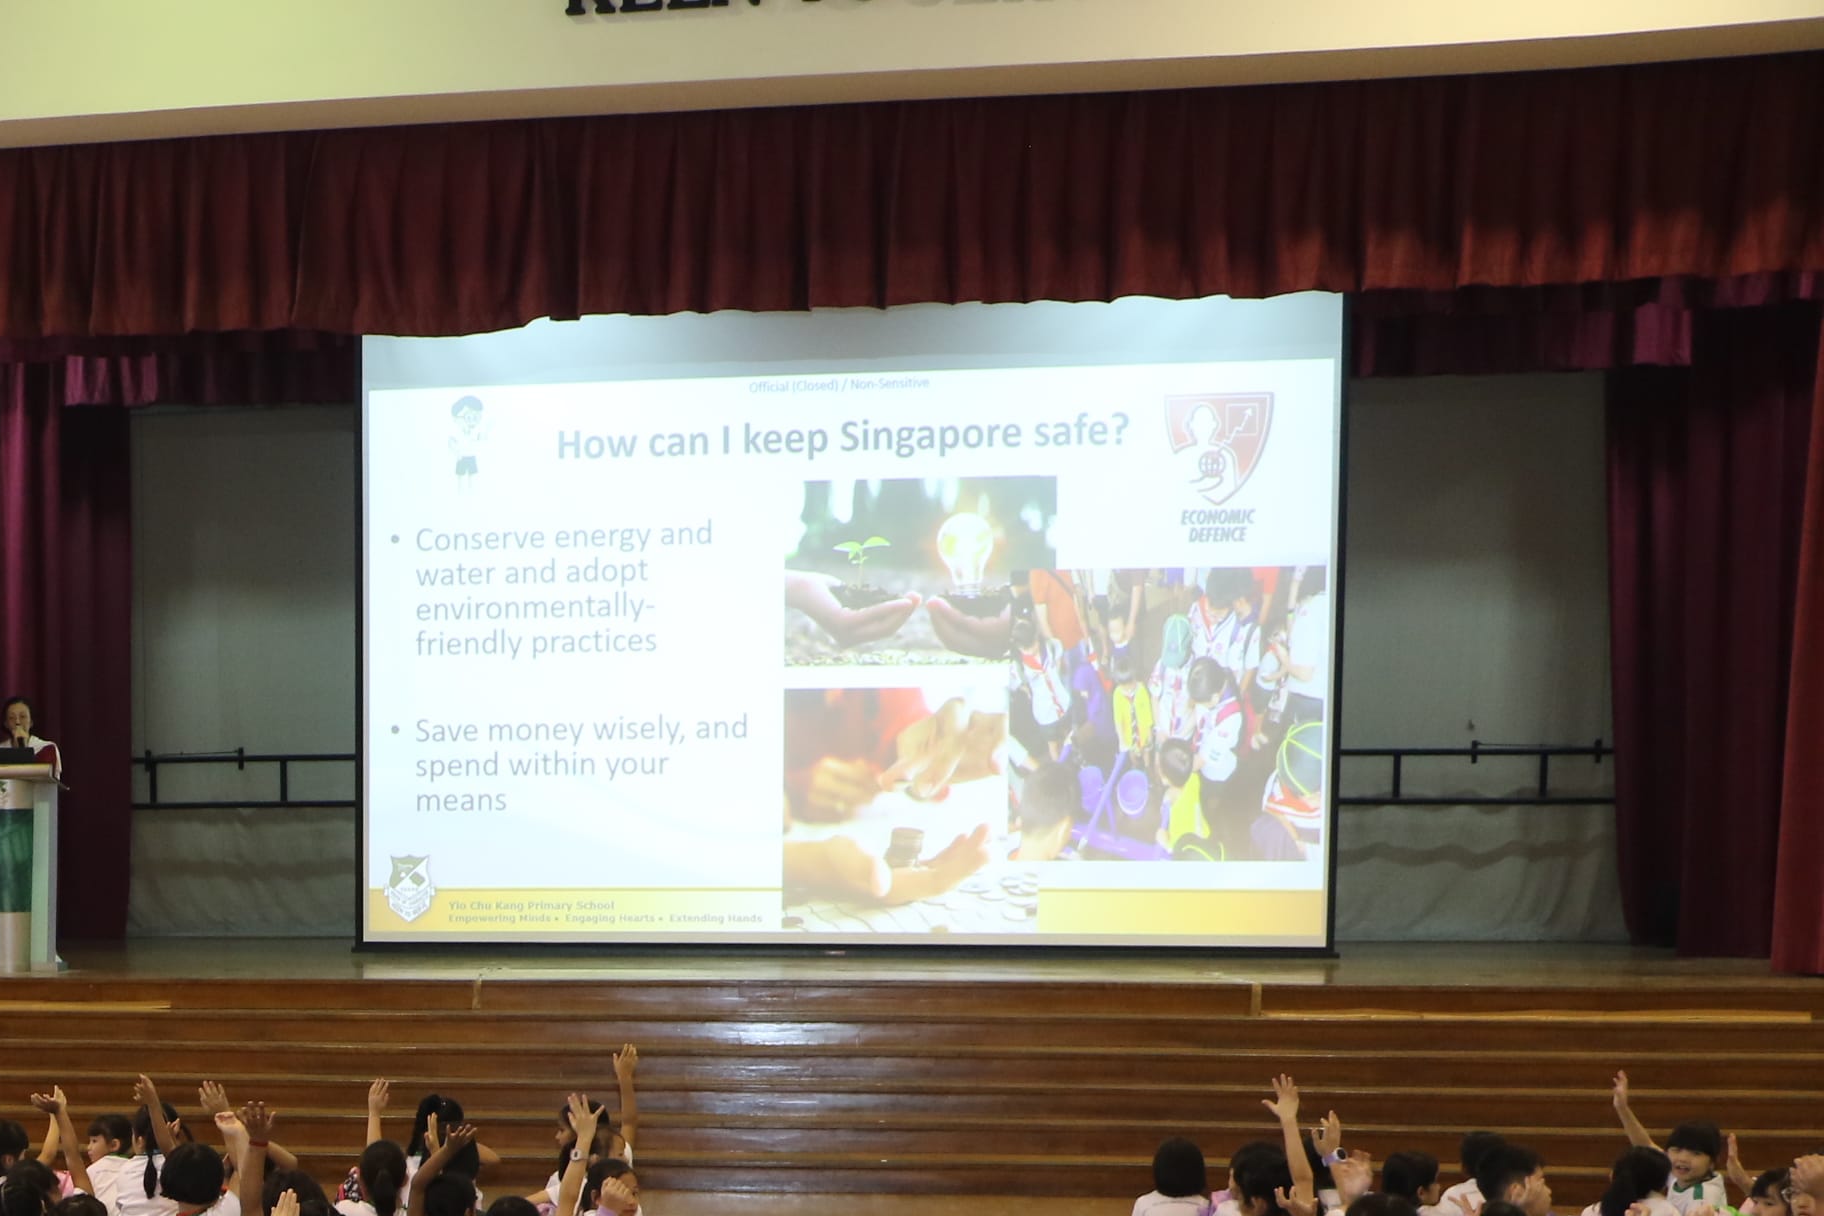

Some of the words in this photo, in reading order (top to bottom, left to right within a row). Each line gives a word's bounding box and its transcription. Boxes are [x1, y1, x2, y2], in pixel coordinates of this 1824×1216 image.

[749, 380, 789, 393] Official
[792, 379, 840, 393] (Closed)
[850, 378, 930, 391] Non-Sensitive
[559, 431, 637, 459] How
[649, 432, 708, 456] can
[723, 426, 729, 454] I
[745, 423, 828, 460] keep
[841, 419, 1021, 458] Singapore
[1035, 412, 1128, 446] safe?
[1181, 509, 1256, 525] ECONOMIC
[416, 528, 544, 551] Conserve
[555, 528, 651, 552] energy
[661, 519, 711, 545] and
[1188, 526, 1247, 542] DEFENCE
[416, 564, 495, 586] water
[505, 558, 555, 584] and
[567, 557, 648, 587] adopt
[417, 591, 654, 622] environmentally-
[416, 629, 522, 659] friendly
[533, 629, 656, 659] practices
[416, 719, 478, 742] Save
[489, 723, 584, 746] money
[594, 714, 685, 745] wisely,
[696, 713, 747, 739] and
[416, 752, 497, 782] spend
[509, 750, 595, 776] within
[606, 757, 669, 781] your
[417, 794, 506, 812] means
[449, 901, 467, 911] Yio
[470, 901, 492, 911] Chu
[495, 901, 524, 912] Kang
[528, 901, 573, 912] Primary
[576, 901, 615, 910] School
[449, 914, 516, 923] Empowering
[565, 914, 616, 924] Engaging
[669, 913, 724, 924] Extending
